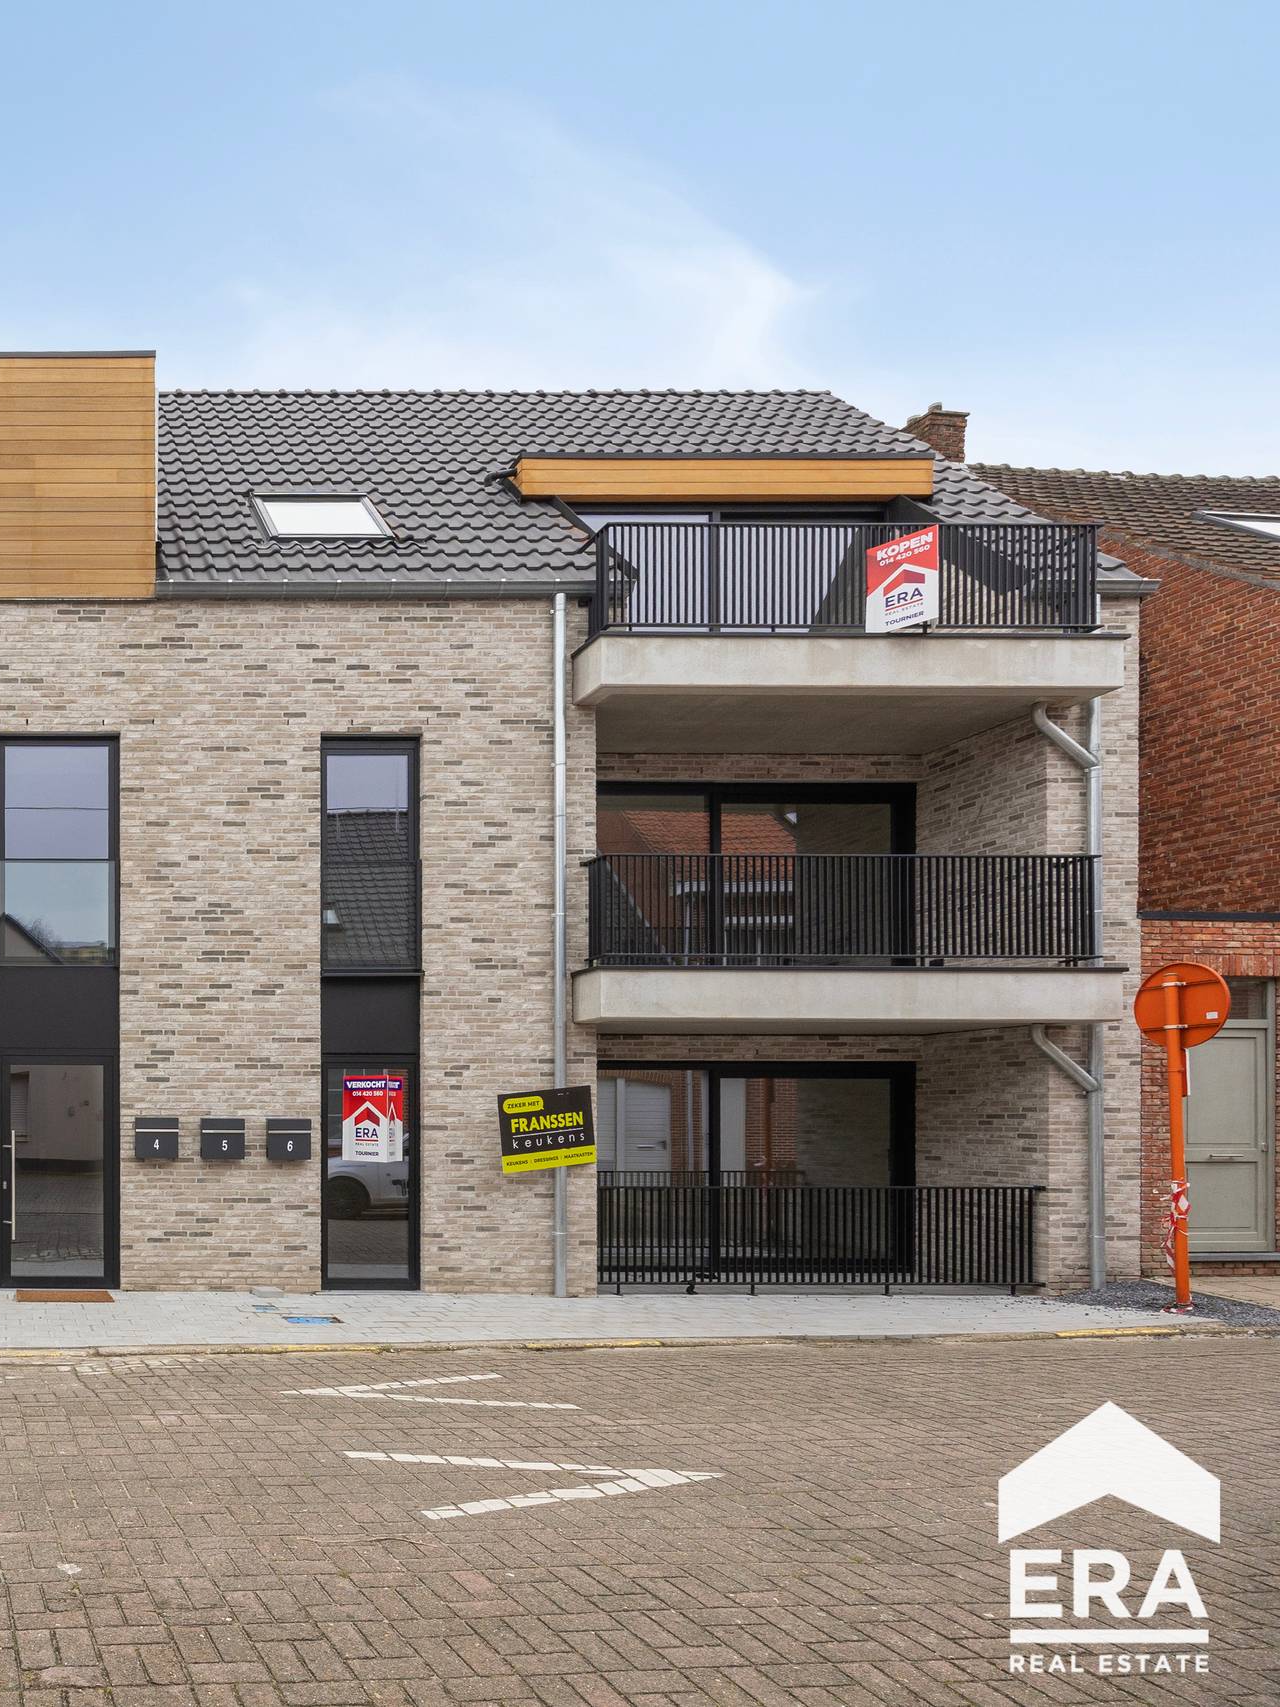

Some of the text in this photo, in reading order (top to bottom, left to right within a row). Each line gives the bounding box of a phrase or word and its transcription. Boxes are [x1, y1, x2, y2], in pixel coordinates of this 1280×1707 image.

[876, 531, 934, 561] KOPEN
[879, 557, 895, 566] 014
[895, 550, 912, 561] 420
[885, 587, 923, 608] ERA
[901, 602, 924, 611] ESTATE
[885, 610, 924, 626] TOURNIER
[346, 1081, 386, 1089] VERKOCHT
[510, 1111, 584, 1133] FRANSSEN
[355, 1127, 379, 1138] ERA
[153, 1139, 160, 1150] 4
[221, 1140, 228, 1151] 5
[287, 1140, 293, 1151] 6
[512, 1132, 585, 1149] keukens
[563, 1151, 593, 1159] MAATKASTEN
